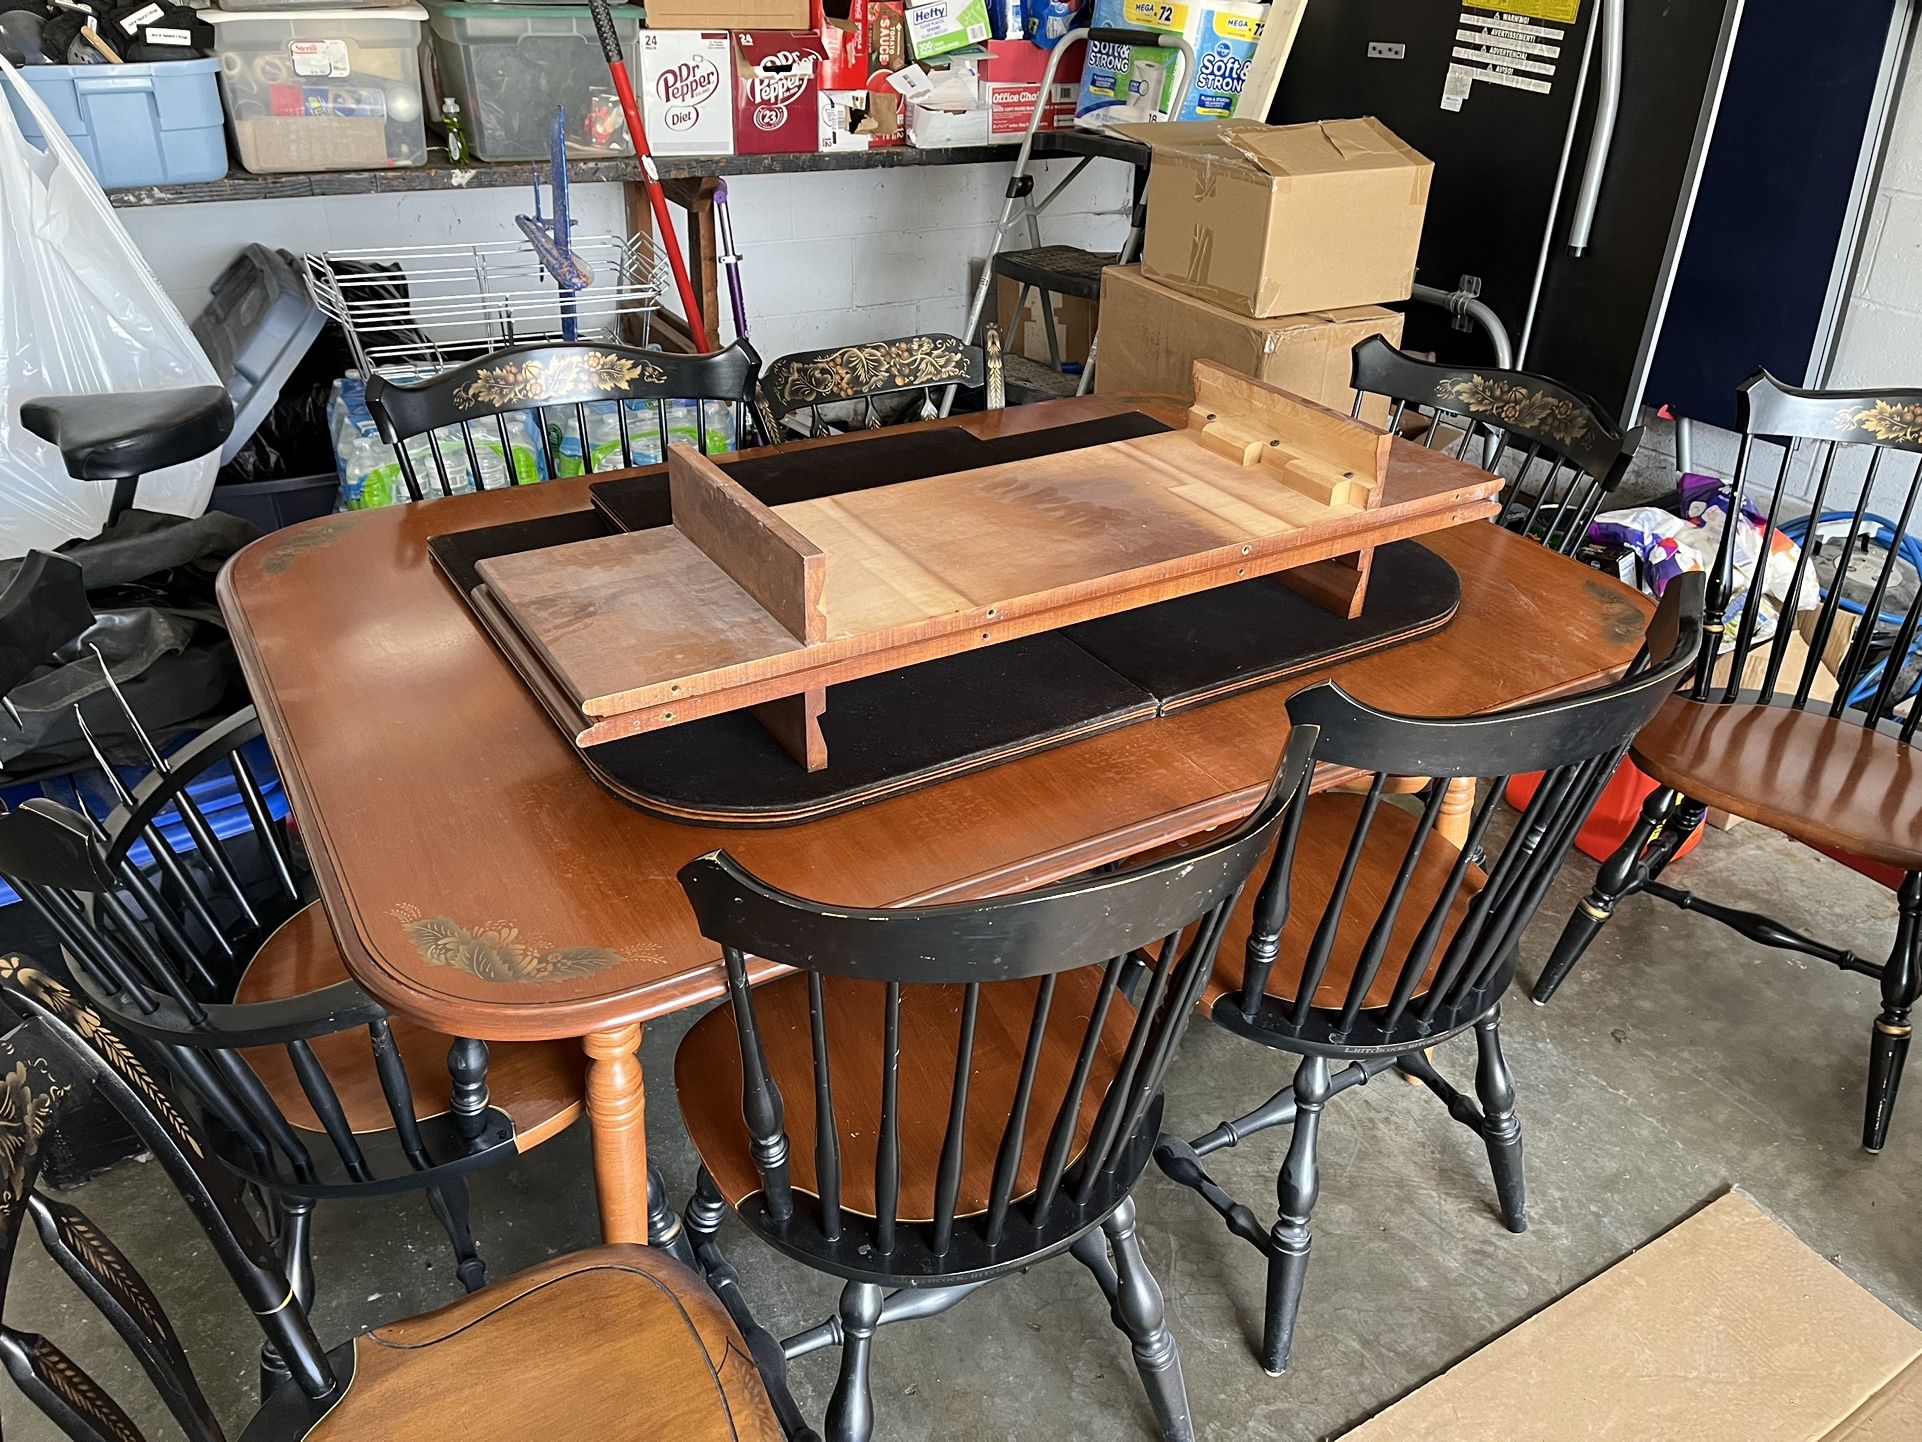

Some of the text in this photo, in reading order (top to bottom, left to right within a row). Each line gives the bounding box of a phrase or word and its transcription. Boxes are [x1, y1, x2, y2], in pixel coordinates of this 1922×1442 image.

[915, 7, 945, 22] Hefty
[1135, 4, 1154, 12] MEGA
[1159, 6, 1173, 22] 72
[1502, 13, 1530, 24] WARNING!
[1227, 19, 1248, 27] MEGA
[645, 35, 657, 46] 24
[879, 19, 891, 62] SAUCE
[1490, 28, 1536, 43] AVERTISSEMENT!
[777, 51, 800, 66] Dr
[1488, 46, 1528, 60] ADVERTENCIA!
[1089, 52, 1129, 72] STRONG
[1201, 54, 1241, 78] Soft
[677, 63, 700, 83] Dr
[1495, 65, 1514, 75] AVISO!
[656, 69, 714, 103] Pepper
[992, 93, 1019, 103] Office
[672, 111, 692, 126] Diet
[763, 110, 777, 124] 23
[896, 128, 904, 138] 12
[824, 137, 832, 148] 12
